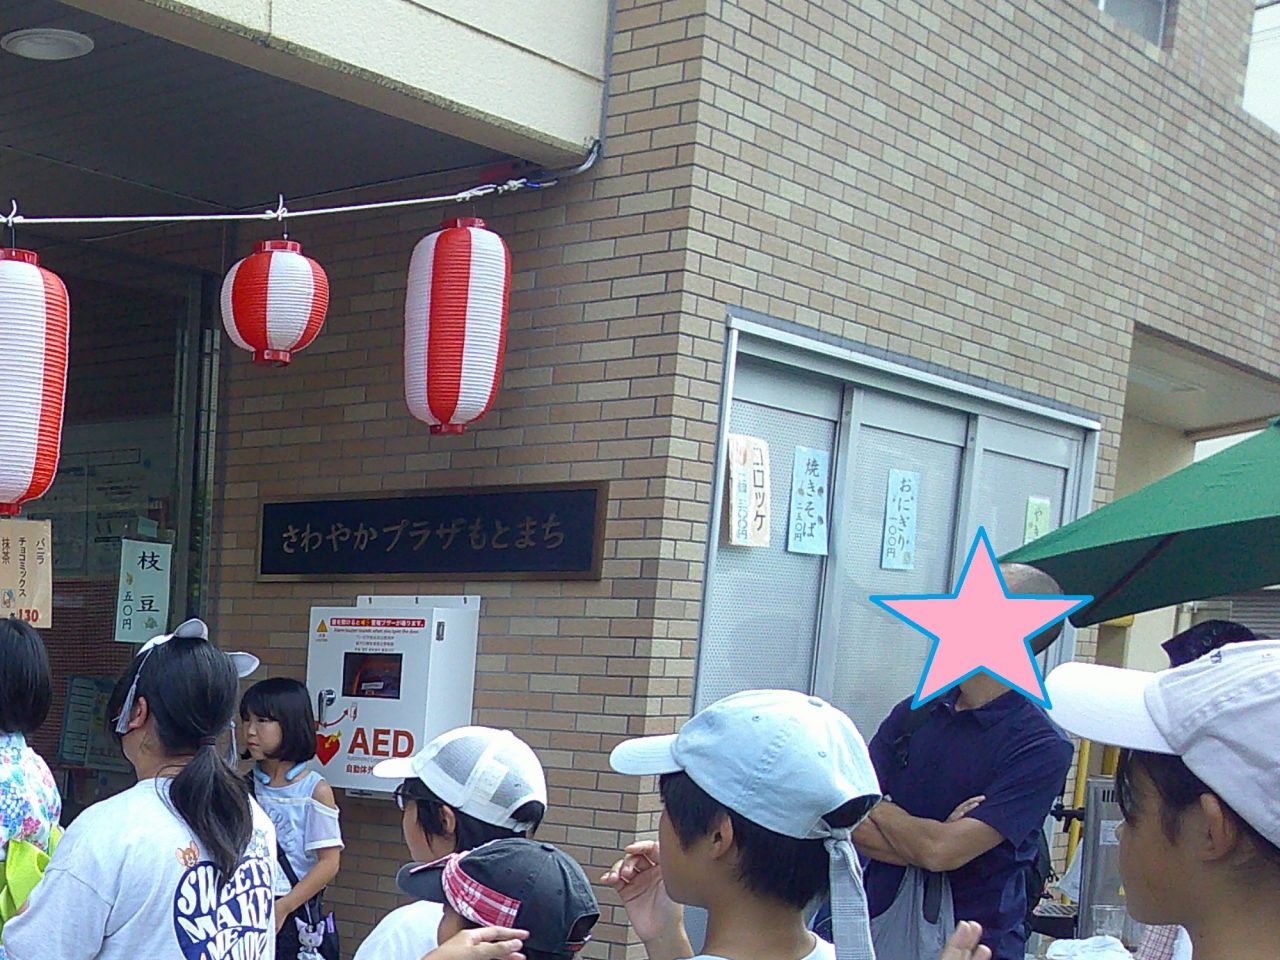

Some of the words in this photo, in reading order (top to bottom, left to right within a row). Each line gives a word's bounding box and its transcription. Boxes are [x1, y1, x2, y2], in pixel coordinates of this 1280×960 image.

[752, 446, 767, 531] コロッケ
[802, 457, 820, 538] 焼きそば
[281, 512, 566, 553] さわやかプラザもとまち
[886, 516, 898, 558] 一〇〇円
[897, 477, 912, 551] おにぎり
[1, 536, 11, 565] 抹茶
[18, 536, 27, 598] チョコミックス
[35, 536, 46, 566] バニラ
[136, 550, 164, 613] 枝豆
[122, 591, 134, 631] 五〇円
[347, 727, 414, 758] AED
[178, 887, 273, 943] MAKE
